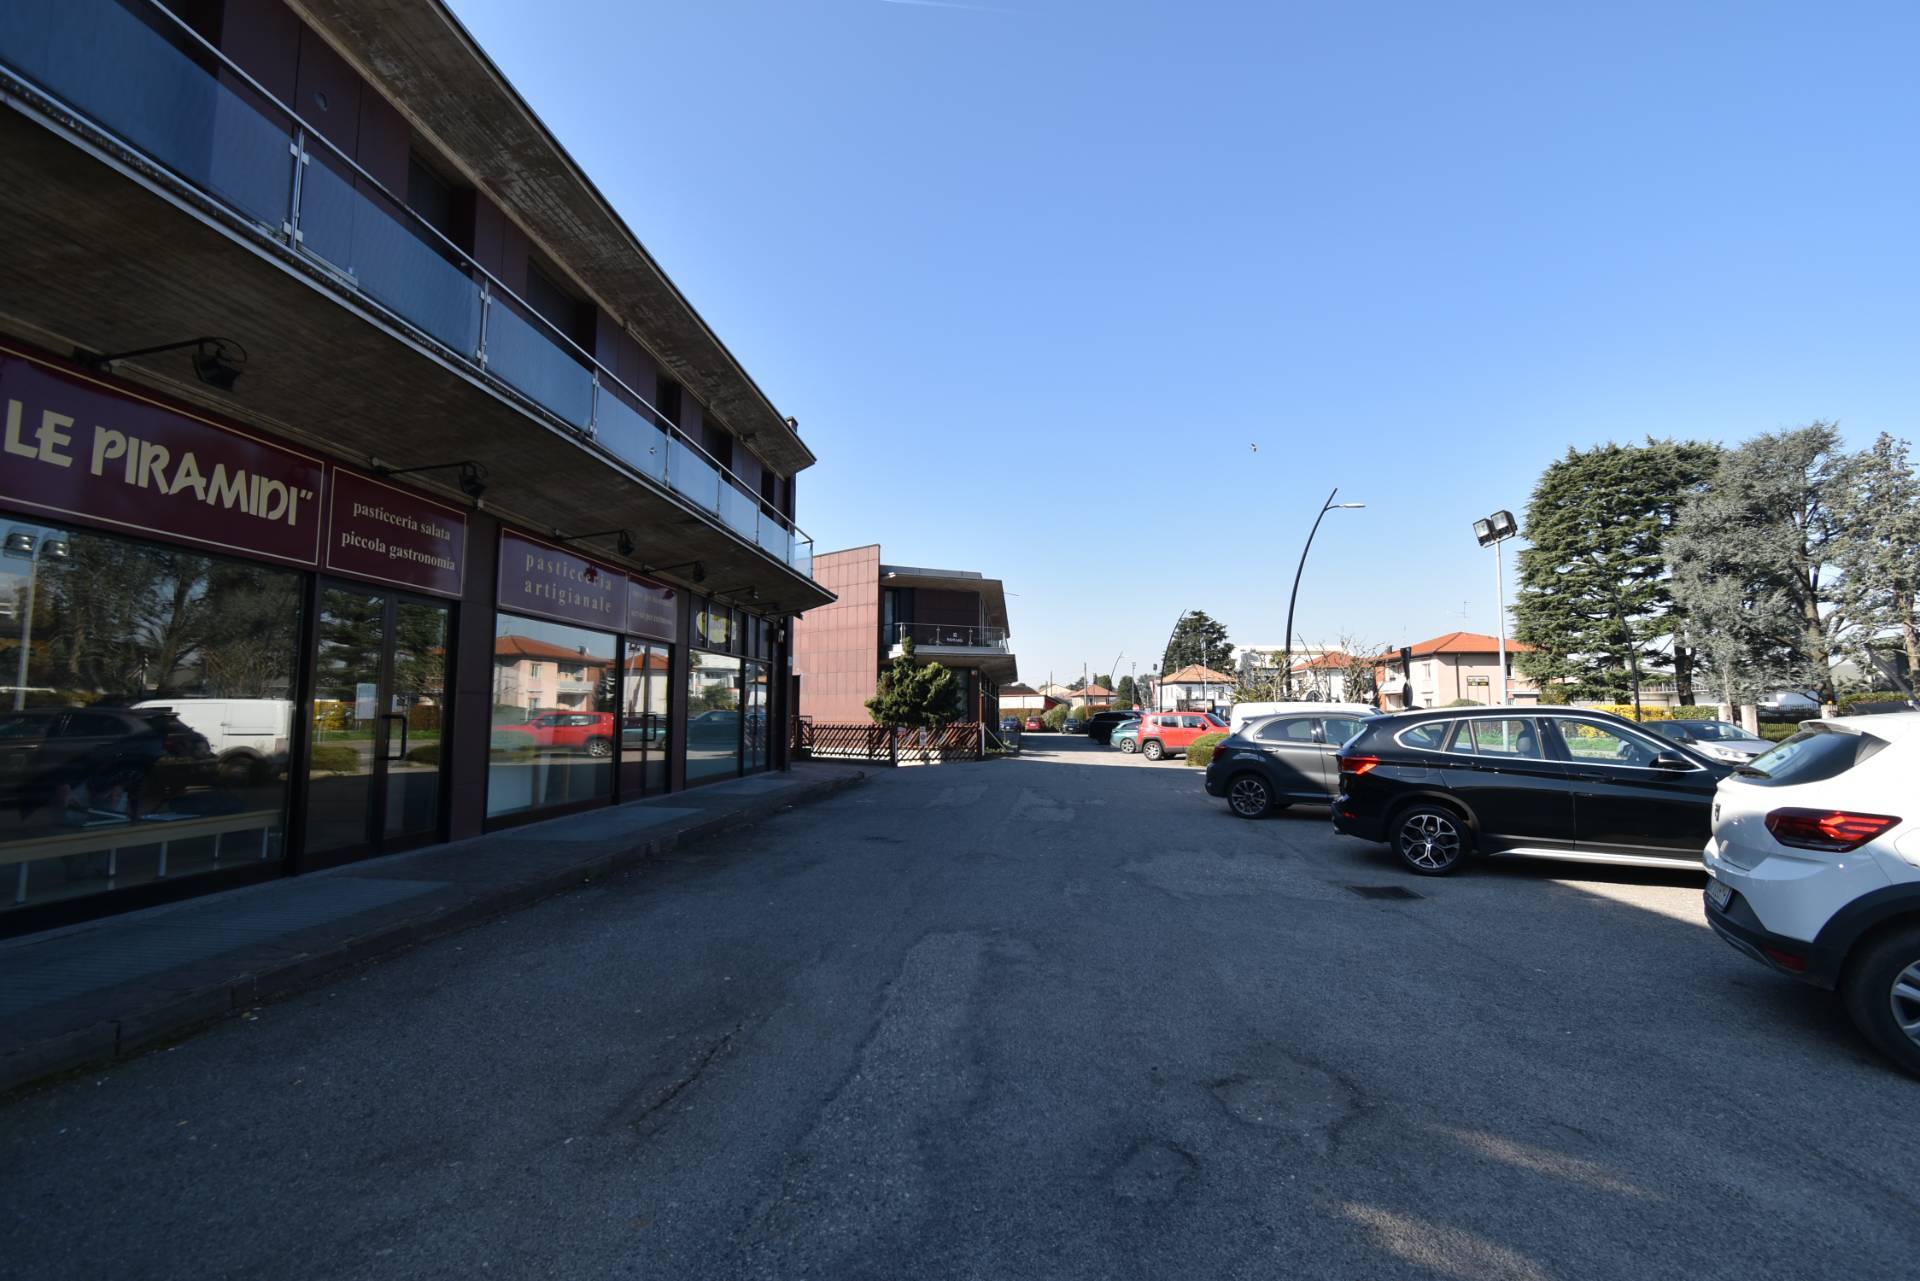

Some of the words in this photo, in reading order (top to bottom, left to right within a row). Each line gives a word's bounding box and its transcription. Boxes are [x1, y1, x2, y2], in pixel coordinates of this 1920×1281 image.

[4, 399, 75, 468] LE
[353, 503, 417, 531] pasticceria
[420, 523, 451, 541] salata
[341, 531, 386, 553] piccola
[389, 545, 455, 571] gastronomia
[526, 554, 612, 592] pasticceria
[524, 579, 611, 613] artigianale
